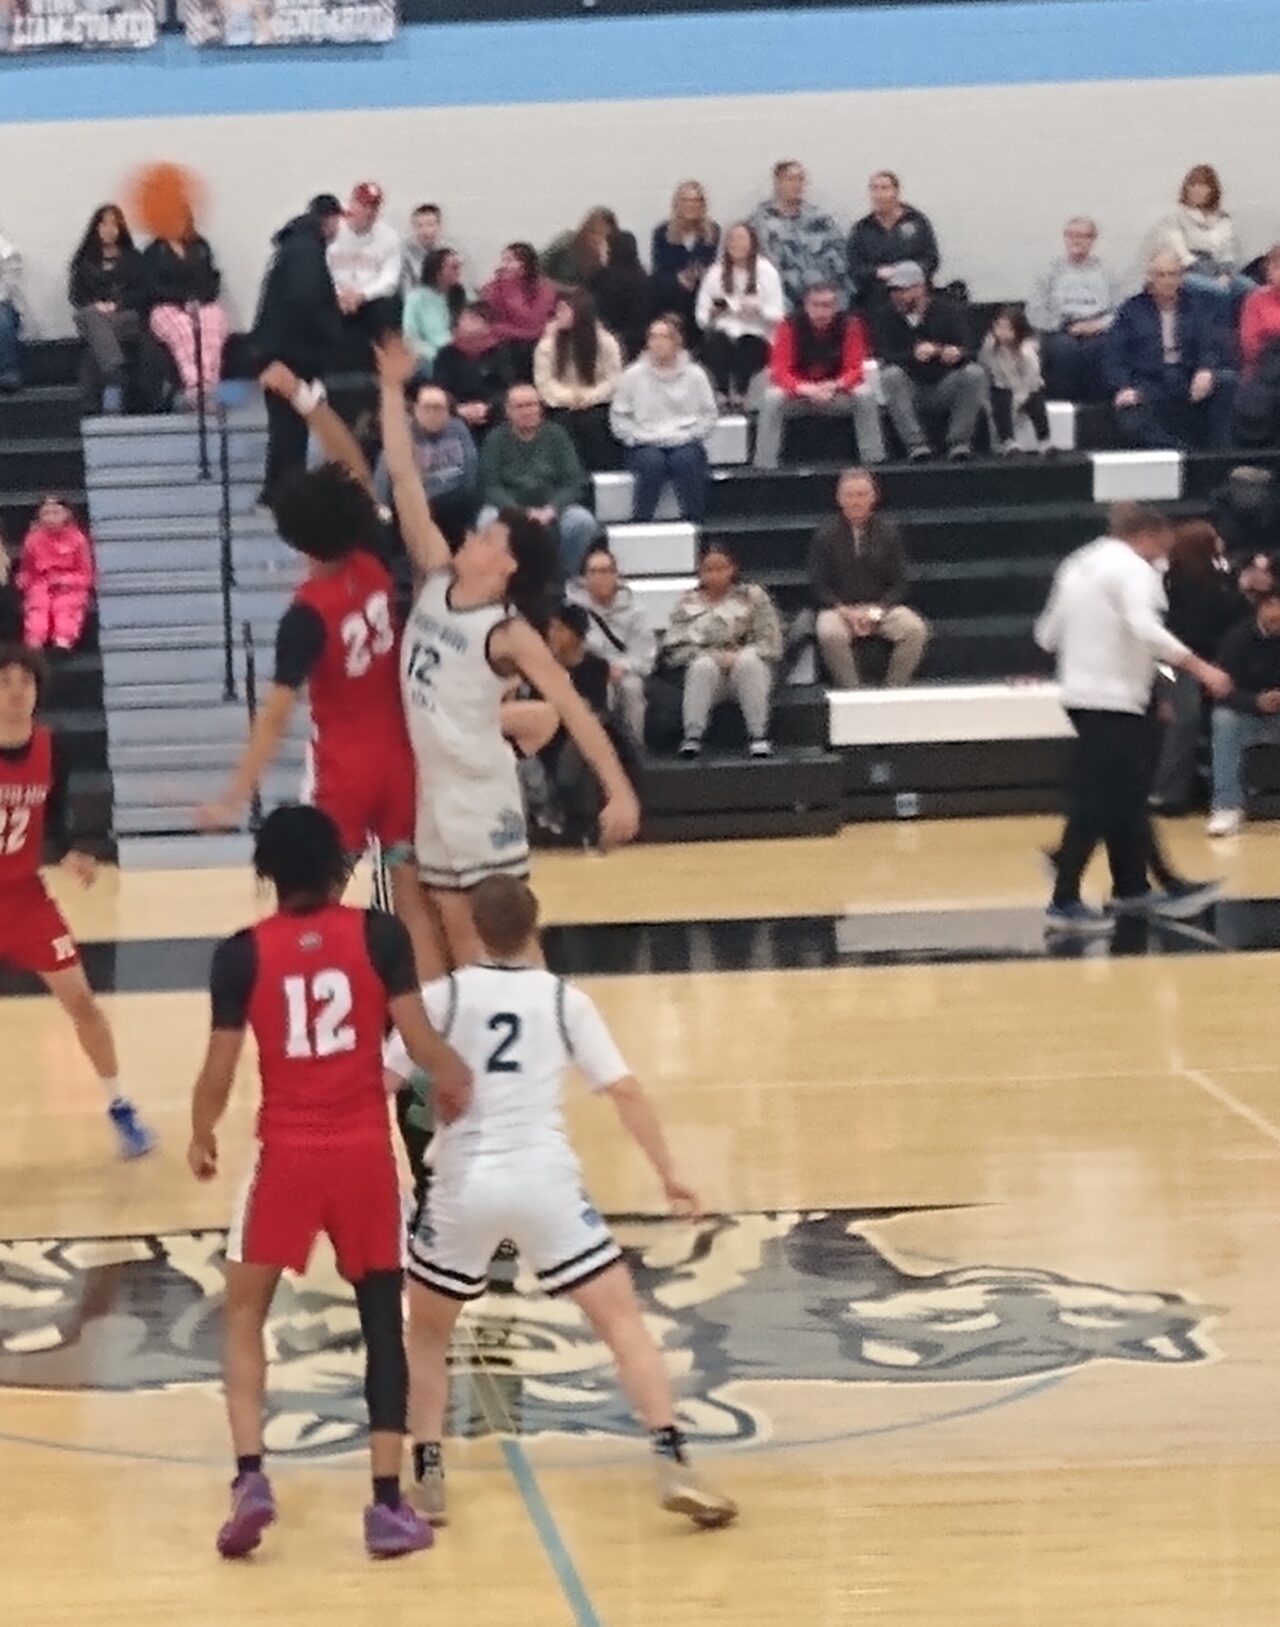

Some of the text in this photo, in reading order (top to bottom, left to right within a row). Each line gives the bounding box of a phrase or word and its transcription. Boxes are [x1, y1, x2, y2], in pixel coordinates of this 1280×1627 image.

[408, 642, 440, 686] 12
[284, 968, 357, 1058] 12
[486, 1012, 521, 1073] 2
